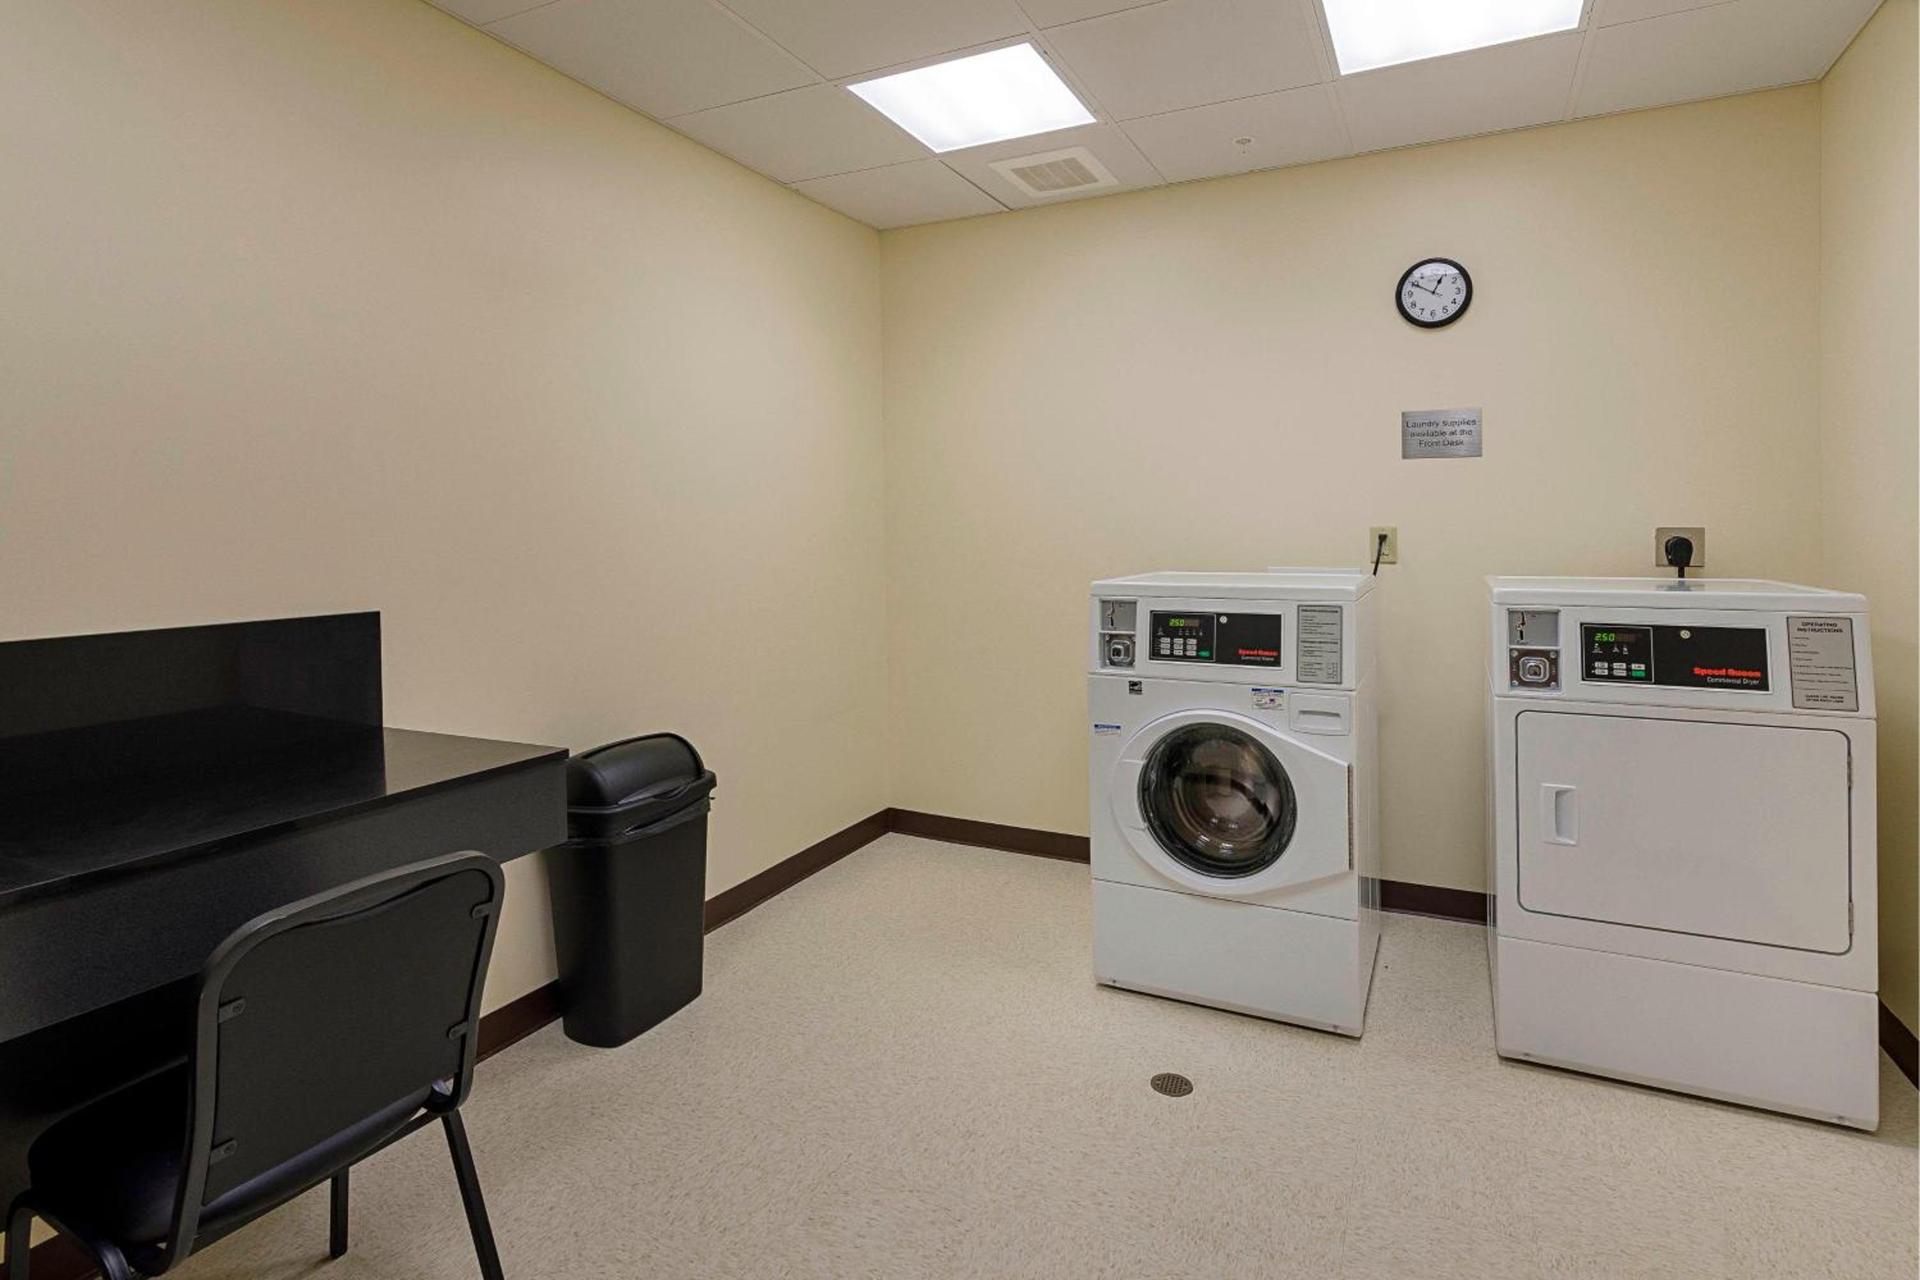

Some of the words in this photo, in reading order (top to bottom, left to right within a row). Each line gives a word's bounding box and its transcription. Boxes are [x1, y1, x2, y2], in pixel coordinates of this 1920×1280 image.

[1407, 290, 1414, 299] 9
[1454, 287, 1461, 295] 3
[1419, 308, 1425, 316] 7
[1430, 309, 1436, 318] 6
[1406, 420, 1439, 429] Laundry
[1419, 439, 1440, 448] Front
[1442, 439, 1465, 447] Desk
[1694, 667, 1726, 676] Speed
[1706, 676, 1742, 684] Commercial
